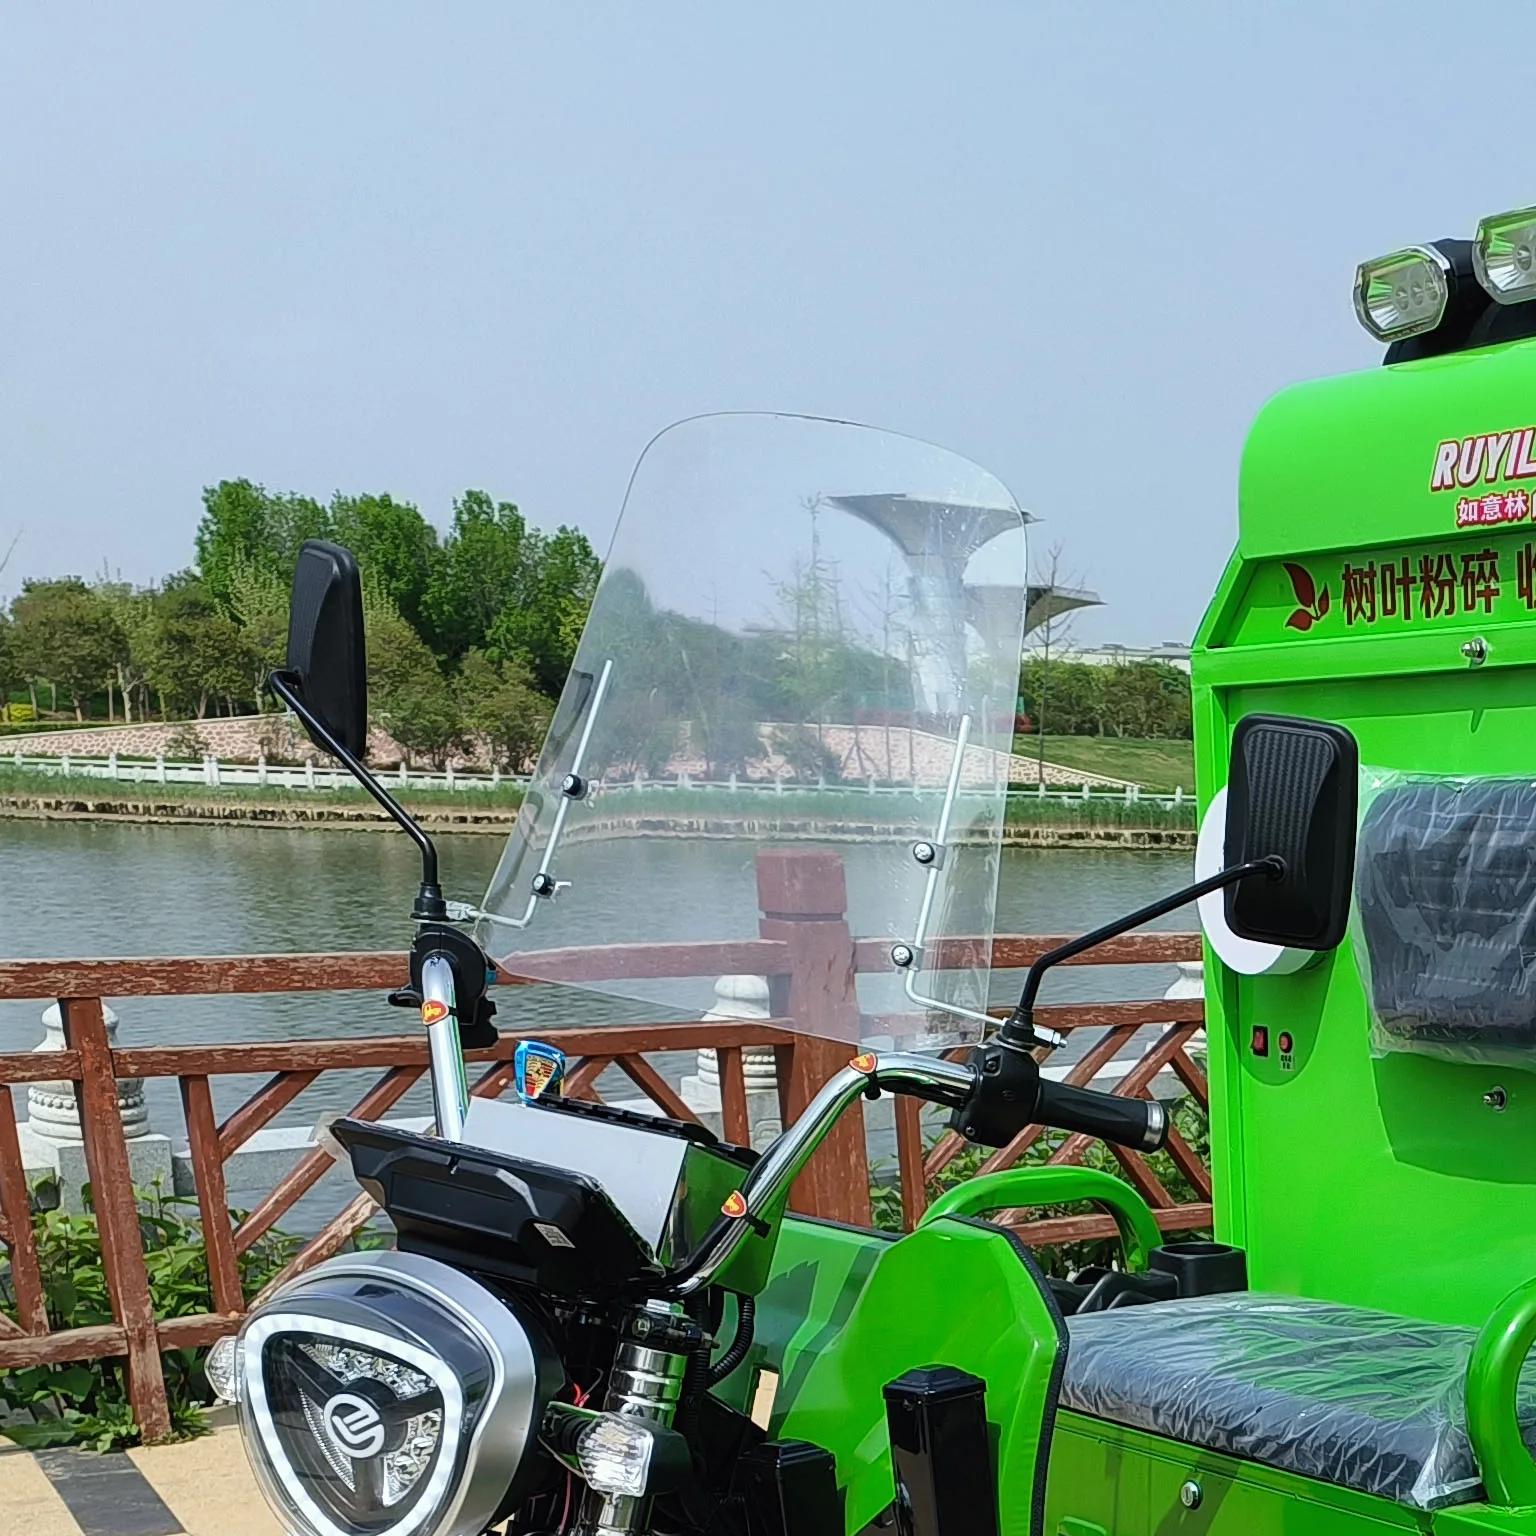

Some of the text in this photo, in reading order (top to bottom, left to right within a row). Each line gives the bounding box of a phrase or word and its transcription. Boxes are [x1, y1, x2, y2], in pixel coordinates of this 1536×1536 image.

[1457, 490, 1529, 528] 如意林
[1342, 548, 1501, 626] 树叶粉碎
